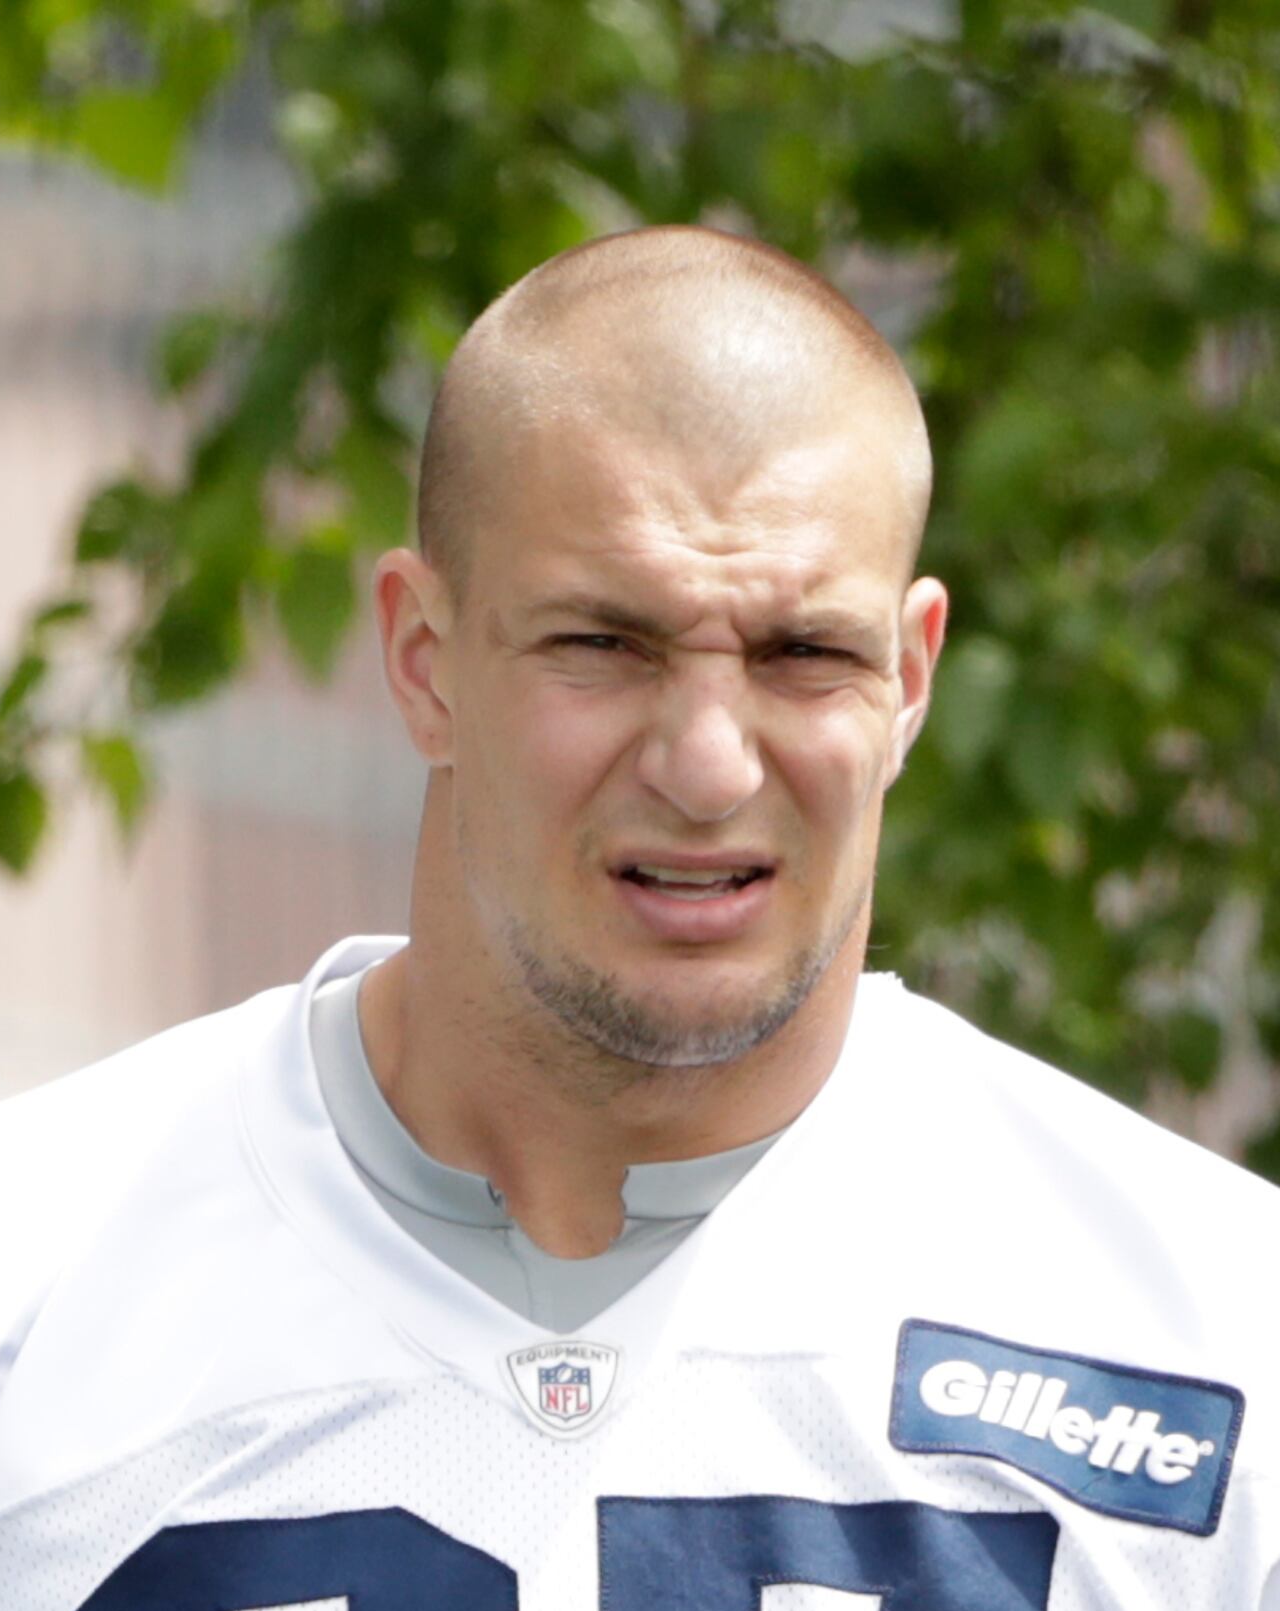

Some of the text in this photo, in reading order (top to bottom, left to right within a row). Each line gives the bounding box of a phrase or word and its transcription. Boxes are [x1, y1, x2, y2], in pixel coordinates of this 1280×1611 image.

[516, 1346, 610, 1366] EQUIPMENT
[544, 1385, 589, 1414] NFL
[920, 1359, 1200, 1485] Gillette
